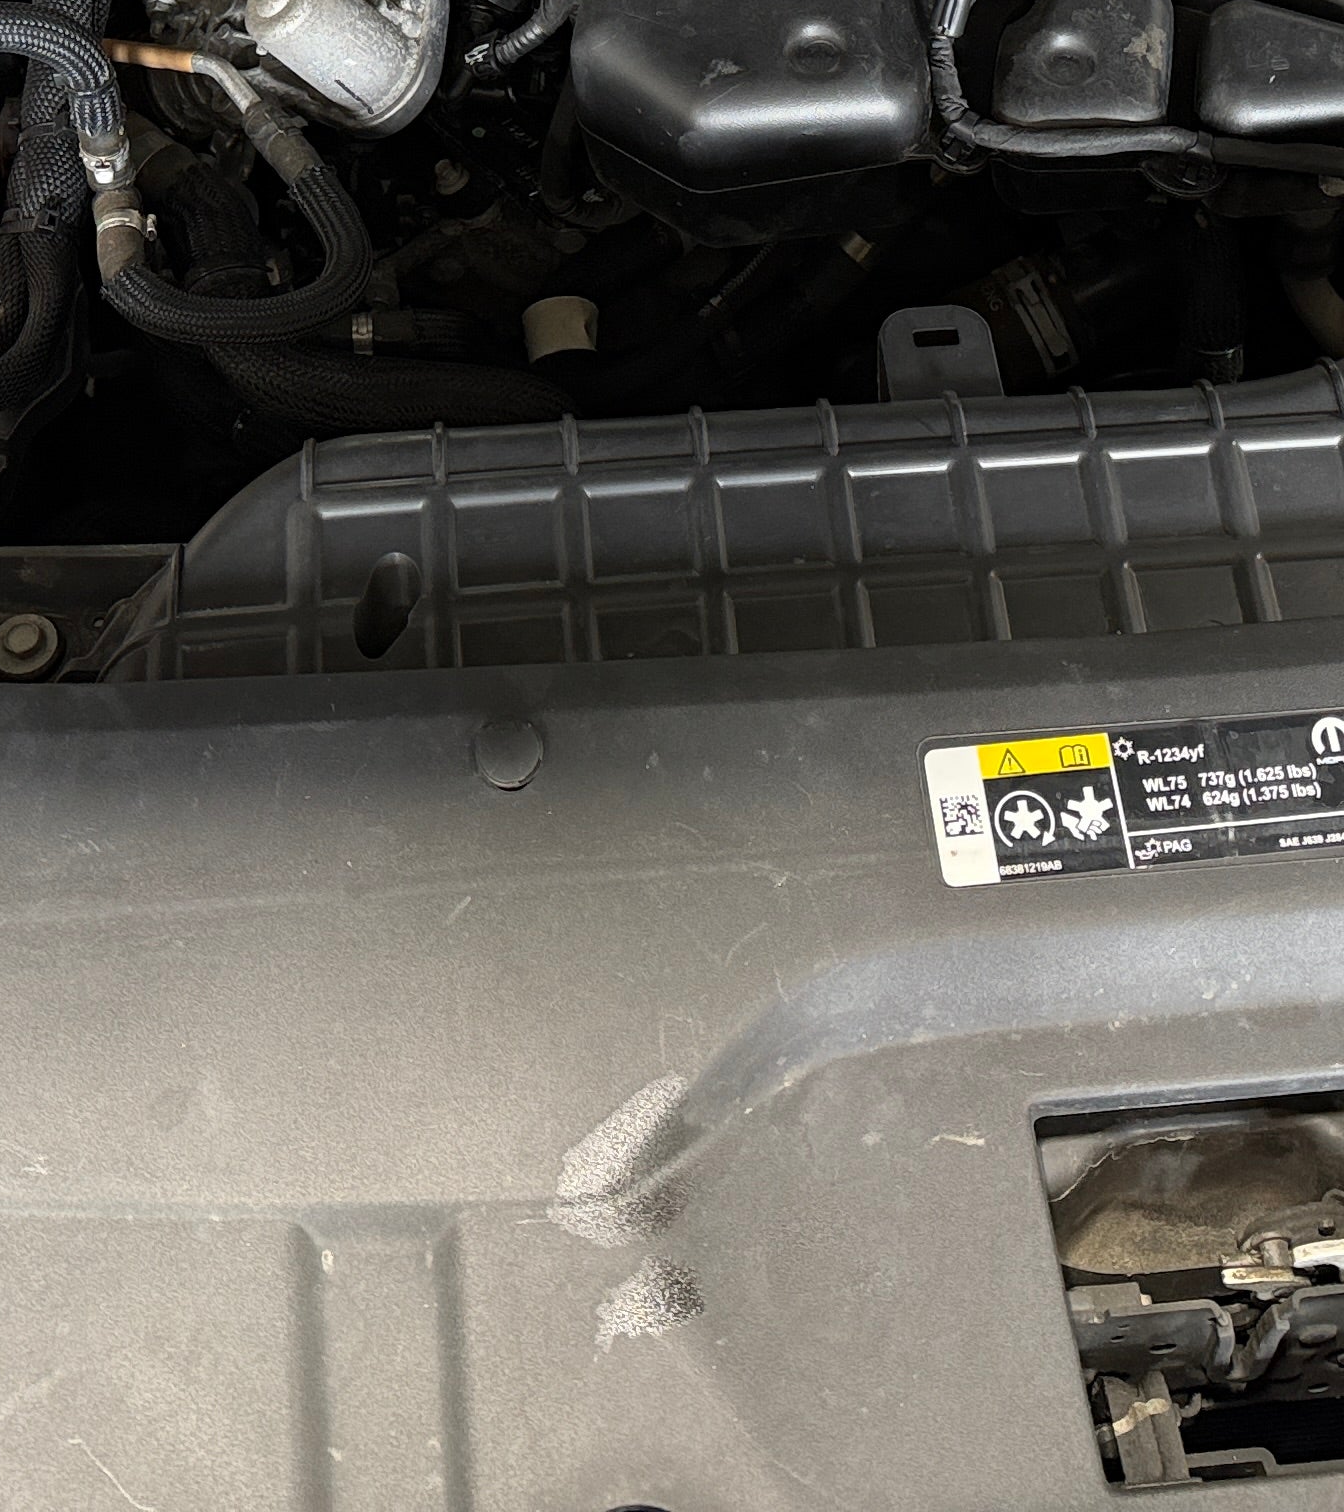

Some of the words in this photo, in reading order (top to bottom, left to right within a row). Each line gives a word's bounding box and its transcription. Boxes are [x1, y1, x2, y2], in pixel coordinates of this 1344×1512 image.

[1136, 743, 1205, 765] R-1234yf
[1142, 775, 1188, 793] WL75
[1198, 770, 1236, 788] 737g
[1239, 766, 1285, 787] (1.625
[1287, 763, 1317, 780] lbs)
[1146, 794, 1192, 812] WL74
[1202, 789, 1241, 807] 624g
[1243, 784, 1290, 805] (1.375
[1292, 782, 1321, 799] lbs)
[1163, 838, 1193, 855] PAG
[1278, 836, 1301, 847] SAE
